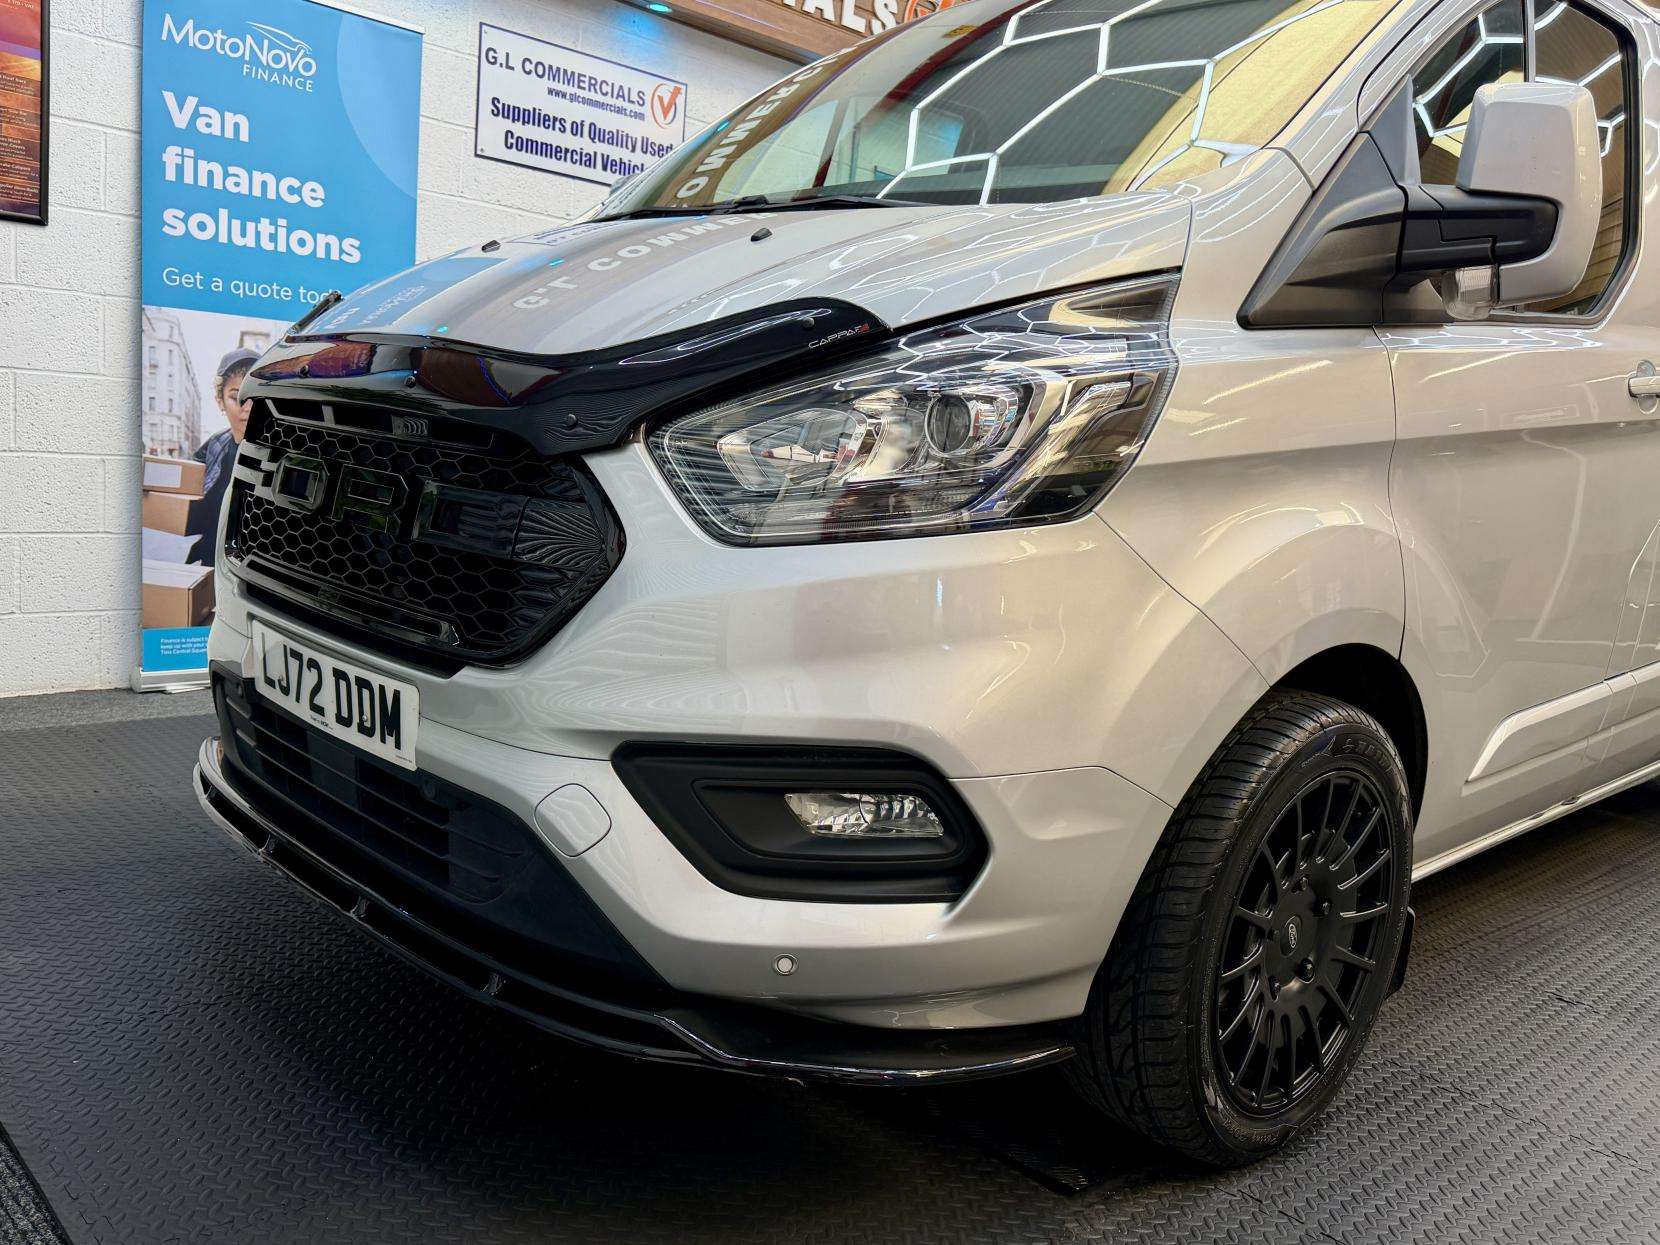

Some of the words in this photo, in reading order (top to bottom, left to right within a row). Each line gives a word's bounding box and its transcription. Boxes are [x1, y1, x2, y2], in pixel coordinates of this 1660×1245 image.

[161, 12, 317, 77] MotoNovo
[243, 64, 313, 92] FINANCE
[484, 46, 515, 71] G.L
[521, 56, 646, 107] COMMERCIALS
[547, 86, 646, 122] www.glcommercials.com
[161, 89, 250, 143] Van
[490, 96, 567, 134] Suppliers
[570, 119, 585, 137] of
[588, 121, 638, 154] Quality
[161, 145, 326, 208] finance
[503, 129, 598, 170] Commercial
[161, 207, 362, 264] solutions
[162, 267, 204, 290] Get
[211, 276, 223, 292] a
[230, 279, 293, 301] quote
[261, 631, 326, 718] LJ72
[332, 666, 402, 751] DDM
